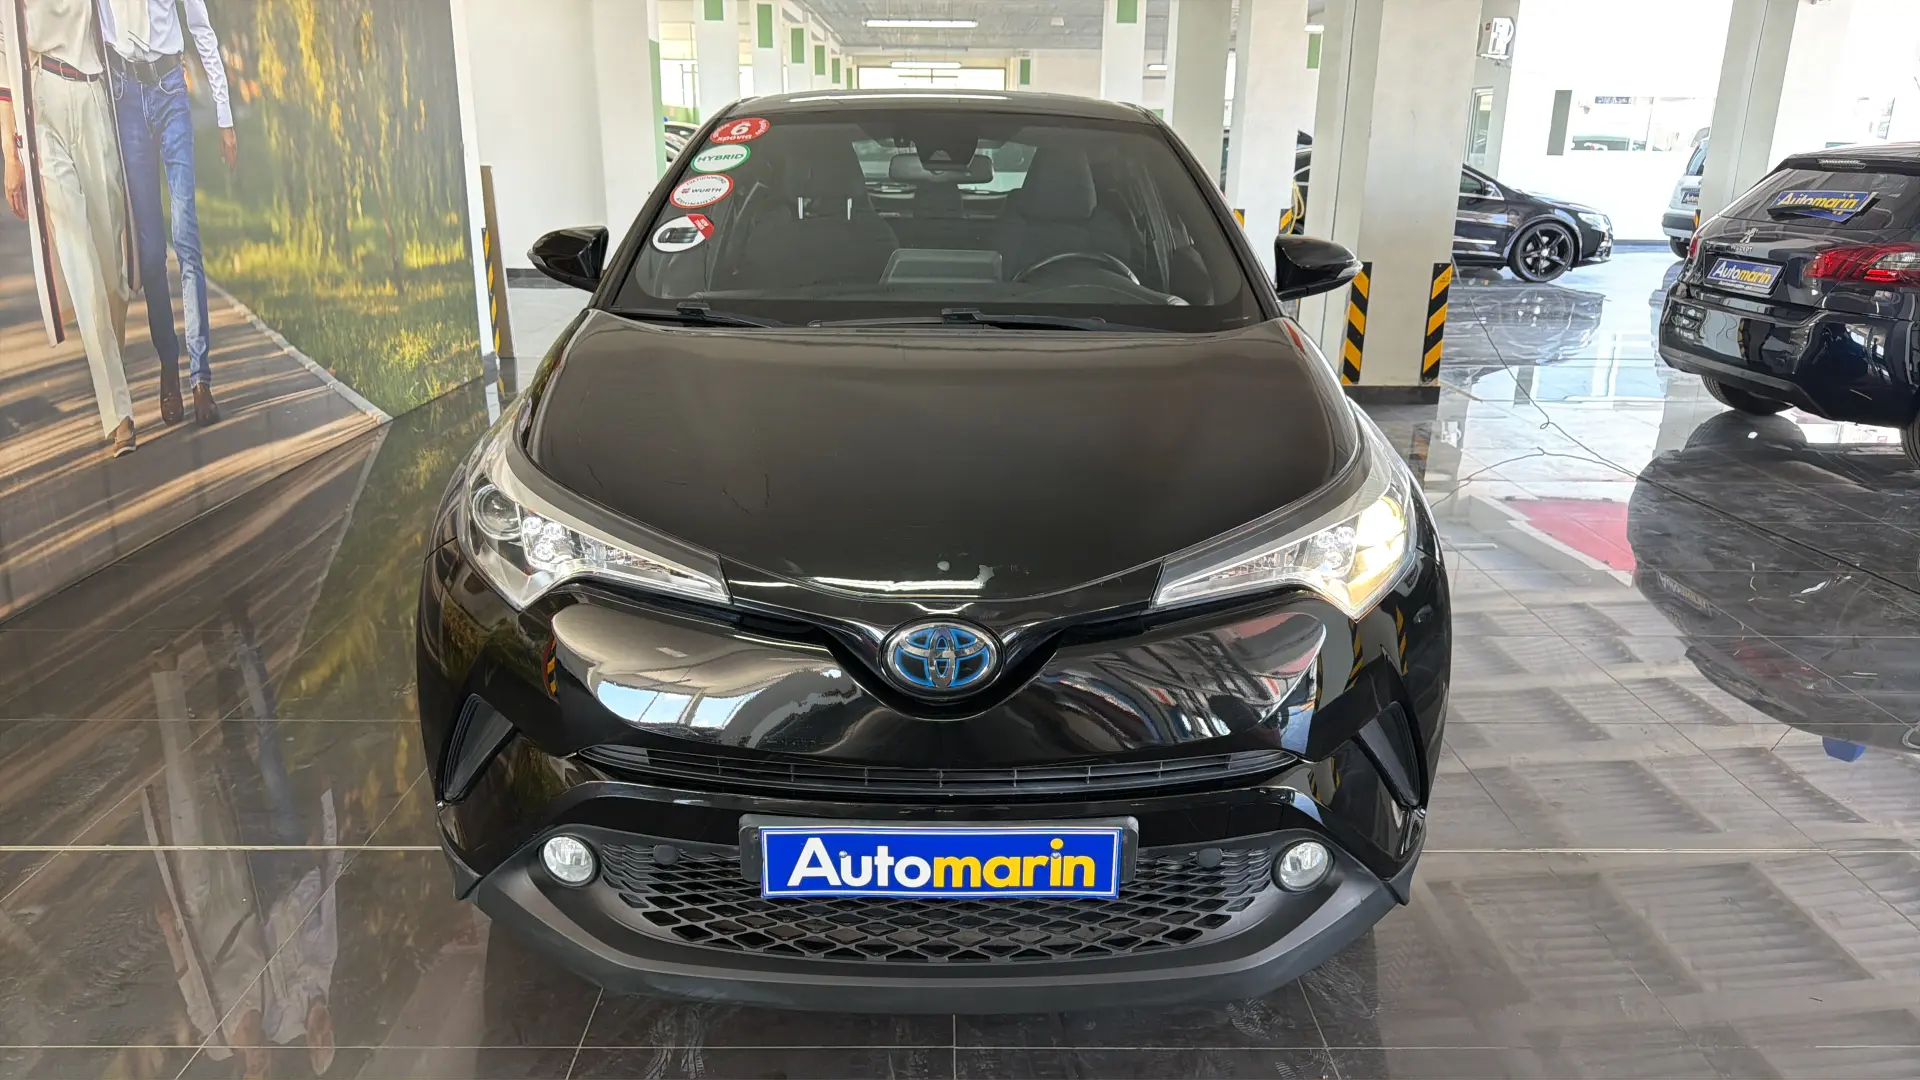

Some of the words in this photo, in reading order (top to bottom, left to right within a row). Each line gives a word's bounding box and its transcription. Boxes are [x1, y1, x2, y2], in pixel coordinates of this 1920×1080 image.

[730, 121, 751, 136] 6
[697, 153, 744, 163] HYBRID
[1777, 192, 1859, 209] Automarin
[1712, 261, 1772, 285] Automarin
[787, 837, 1096, 888] Automarin
